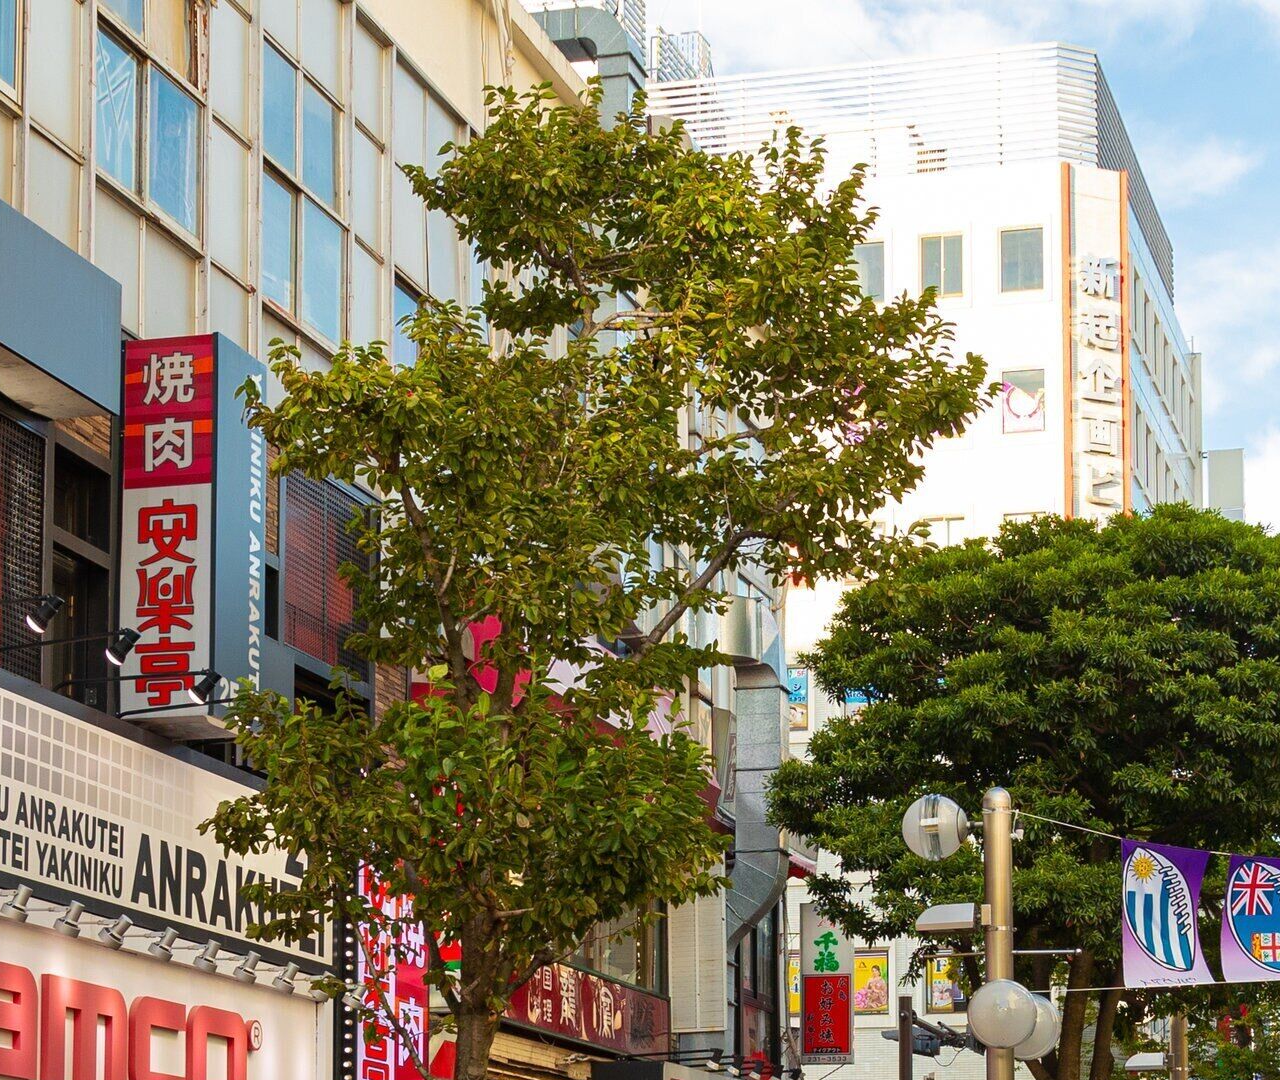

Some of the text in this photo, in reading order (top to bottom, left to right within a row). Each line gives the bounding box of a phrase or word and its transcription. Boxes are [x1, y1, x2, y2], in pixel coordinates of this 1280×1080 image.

[142, 351, 195, 473] 焼肉
[134, 498, 199, 707] 安楽亭
[18, 791, 125, 859] ANRAKUTEI
[35, 839, 124, 899] YAKINIKU
[813, 930, 840, 973] 千福
